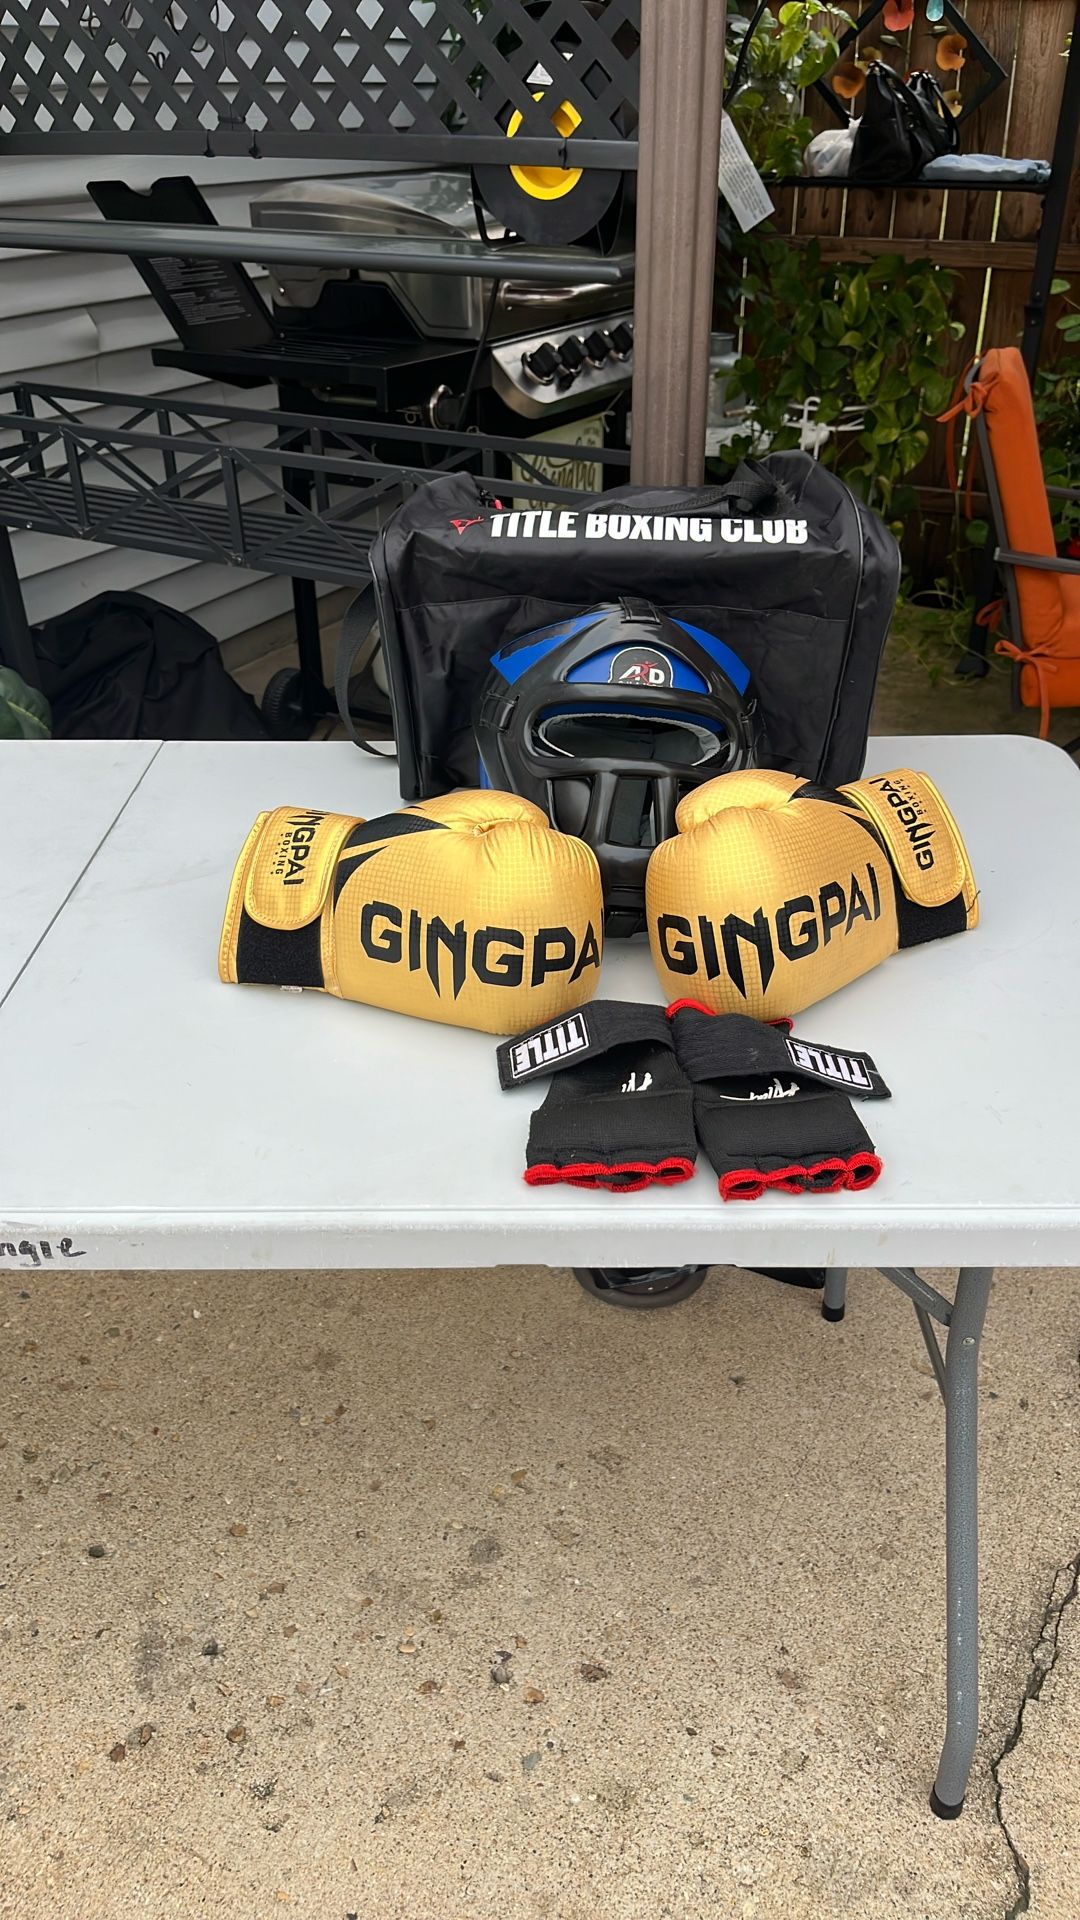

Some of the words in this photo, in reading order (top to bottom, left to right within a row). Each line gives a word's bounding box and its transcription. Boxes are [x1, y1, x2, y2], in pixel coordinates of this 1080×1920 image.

[490, 510, 579, 538] TITLE
[585, 514, 712, 542] BOXING
[720, 518, 808, 544] CLUB
[894, 779, 925, 815] BOXING
[869, 778, 936, 870] GINGPAI
[273, 832, 293, 874] BOXING
[361, 901, 603, 1000] GINGPA
[658, 863, 880, 999] GINGPAI
[514, 1021, 584, 1072] TITLE
[793, 1044, 869, 1085] TITLE
